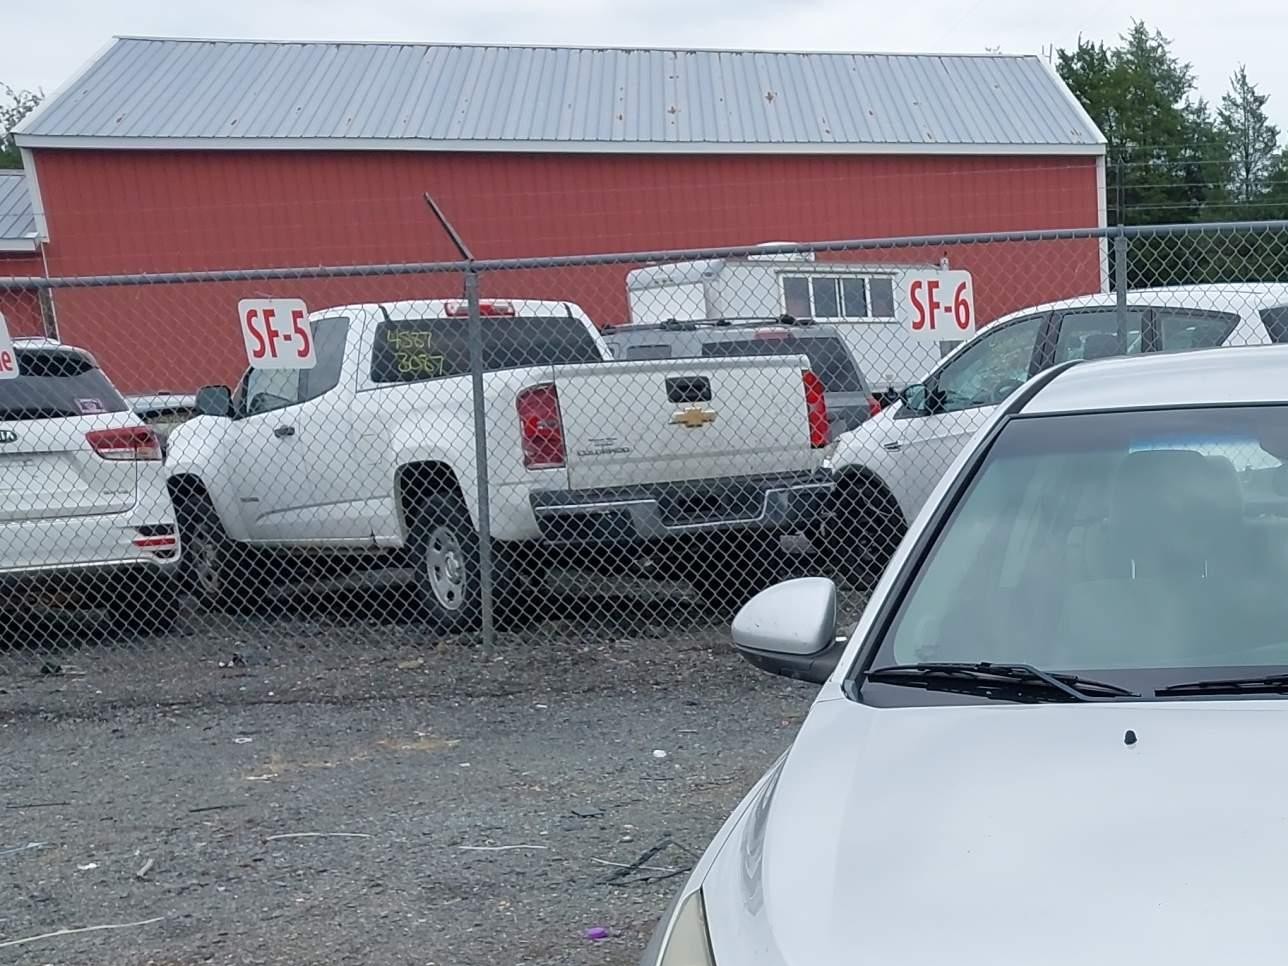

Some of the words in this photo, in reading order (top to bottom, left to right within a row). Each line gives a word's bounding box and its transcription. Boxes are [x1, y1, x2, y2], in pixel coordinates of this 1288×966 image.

[910, 280, 970, 330] SF-6
[246, 308, 310, 359] SF-5
[0, 351, 13, 371] e
